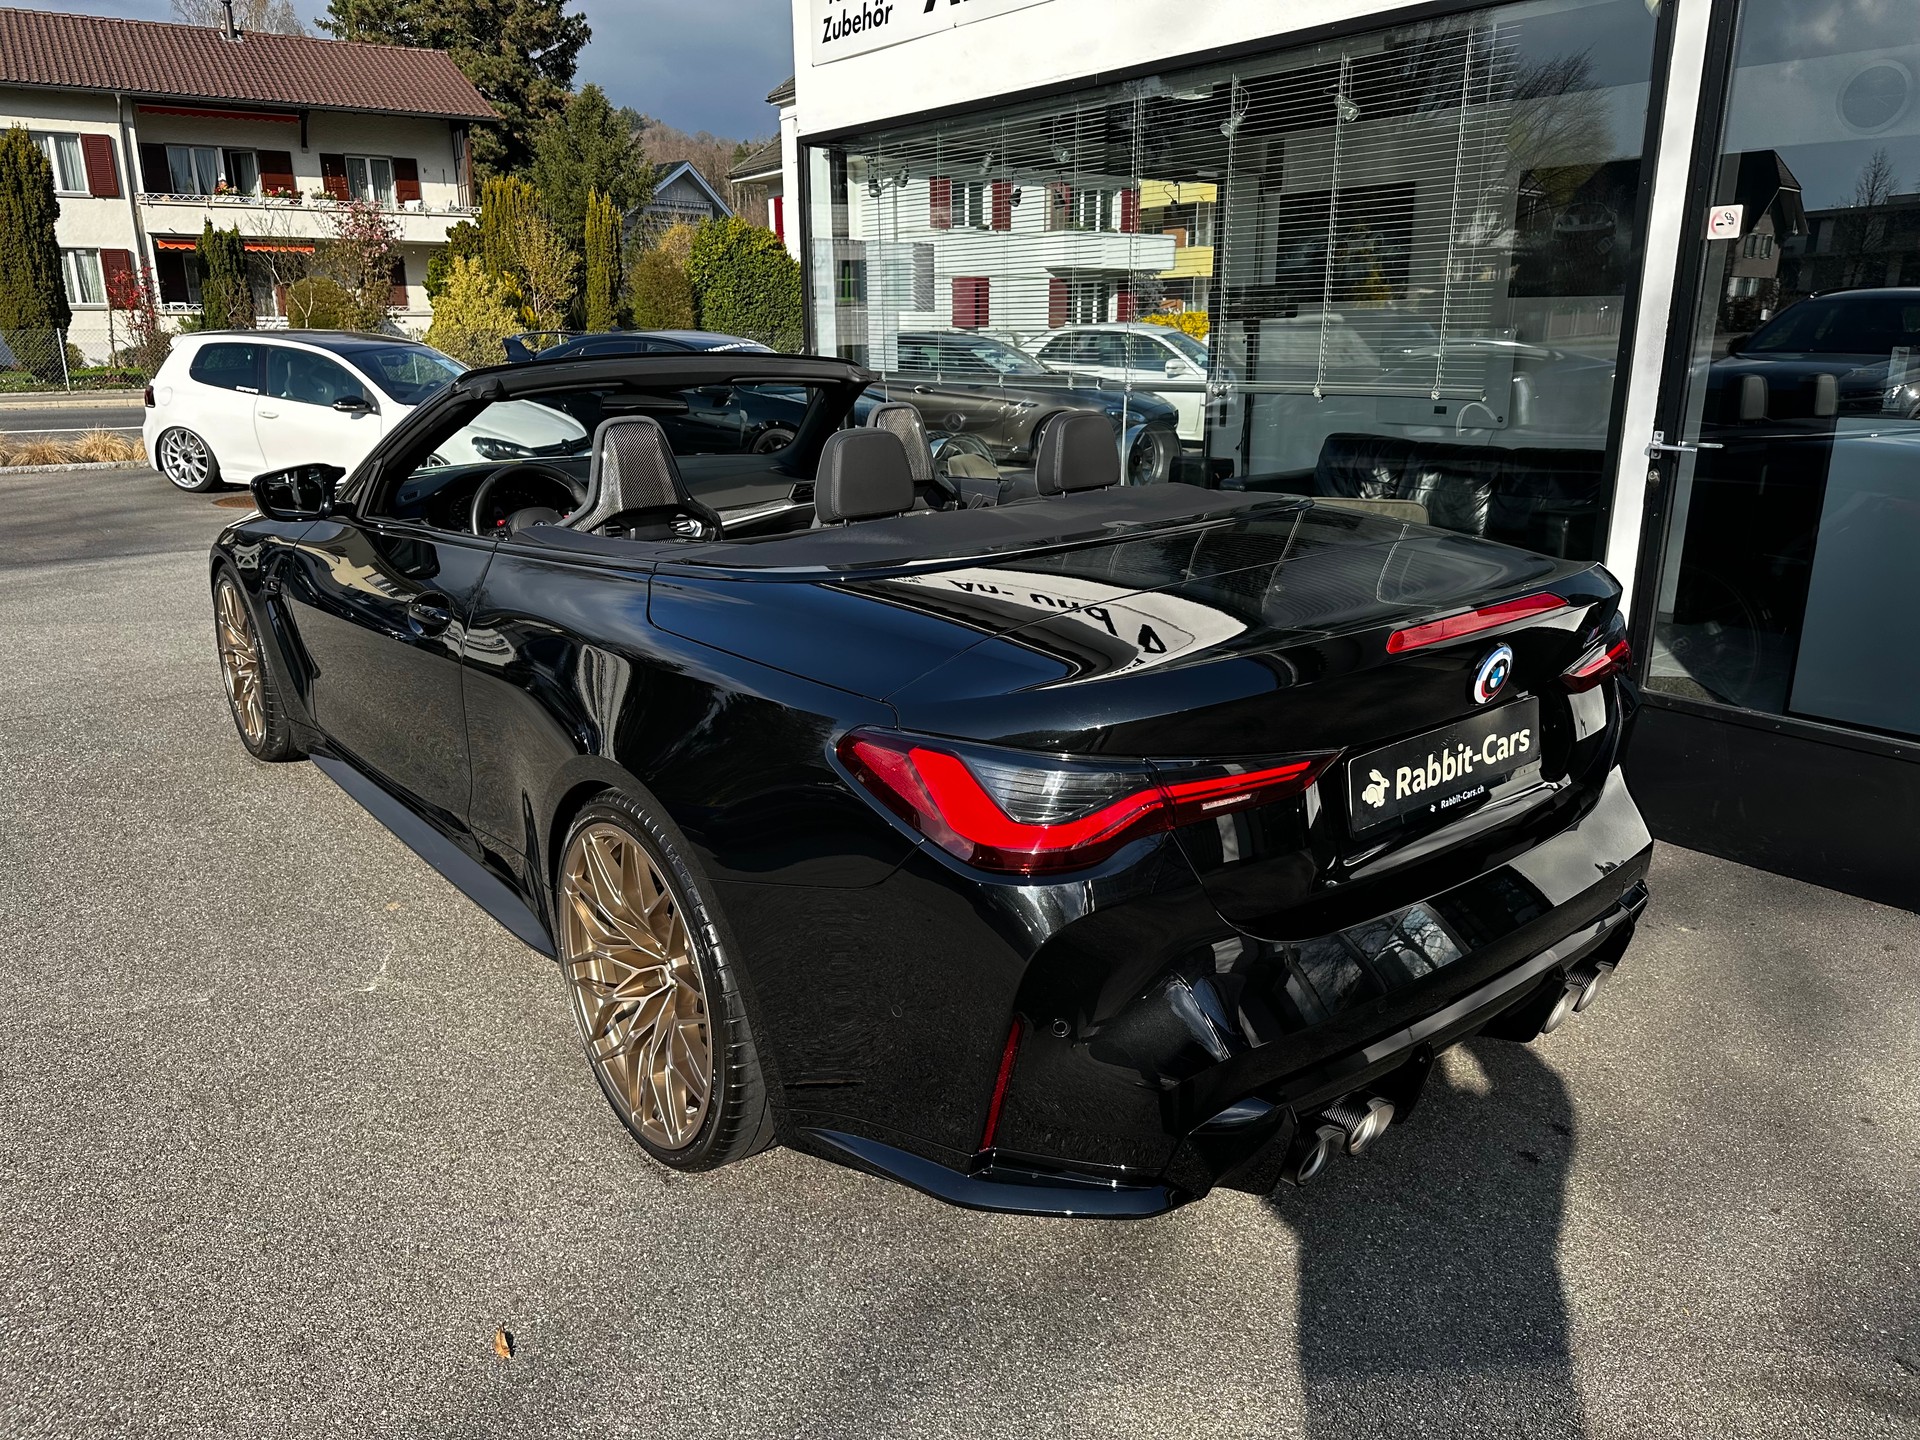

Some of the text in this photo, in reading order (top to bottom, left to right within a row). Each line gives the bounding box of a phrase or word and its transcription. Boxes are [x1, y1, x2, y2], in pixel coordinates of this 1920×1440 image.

[822, 0, 893, 44] Zubehör
[1395, 728, 1531, 800] Rabbit-Cars
[1440, 784, 1485, 809] Rabbit-Cars.ch
